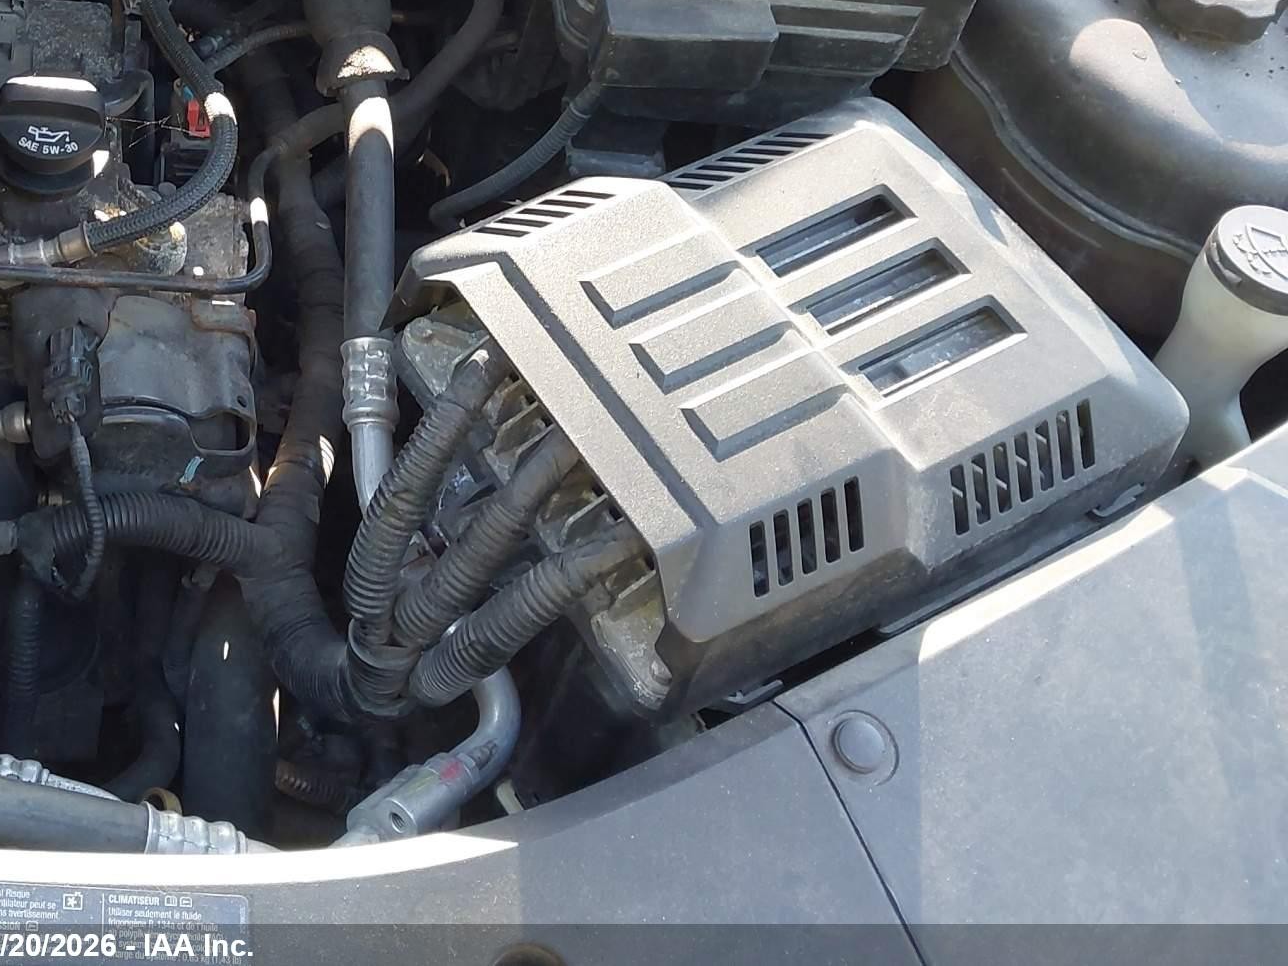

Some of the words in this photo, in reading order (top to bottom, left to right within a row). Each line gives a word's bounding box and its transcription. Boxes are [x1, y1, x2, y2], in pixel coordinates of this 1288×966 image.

[18, 136, 40, 152] SAE
[42, 141, 79, 155] 5W-30
[108, 894, 160, 907] CLIMATISEUR
